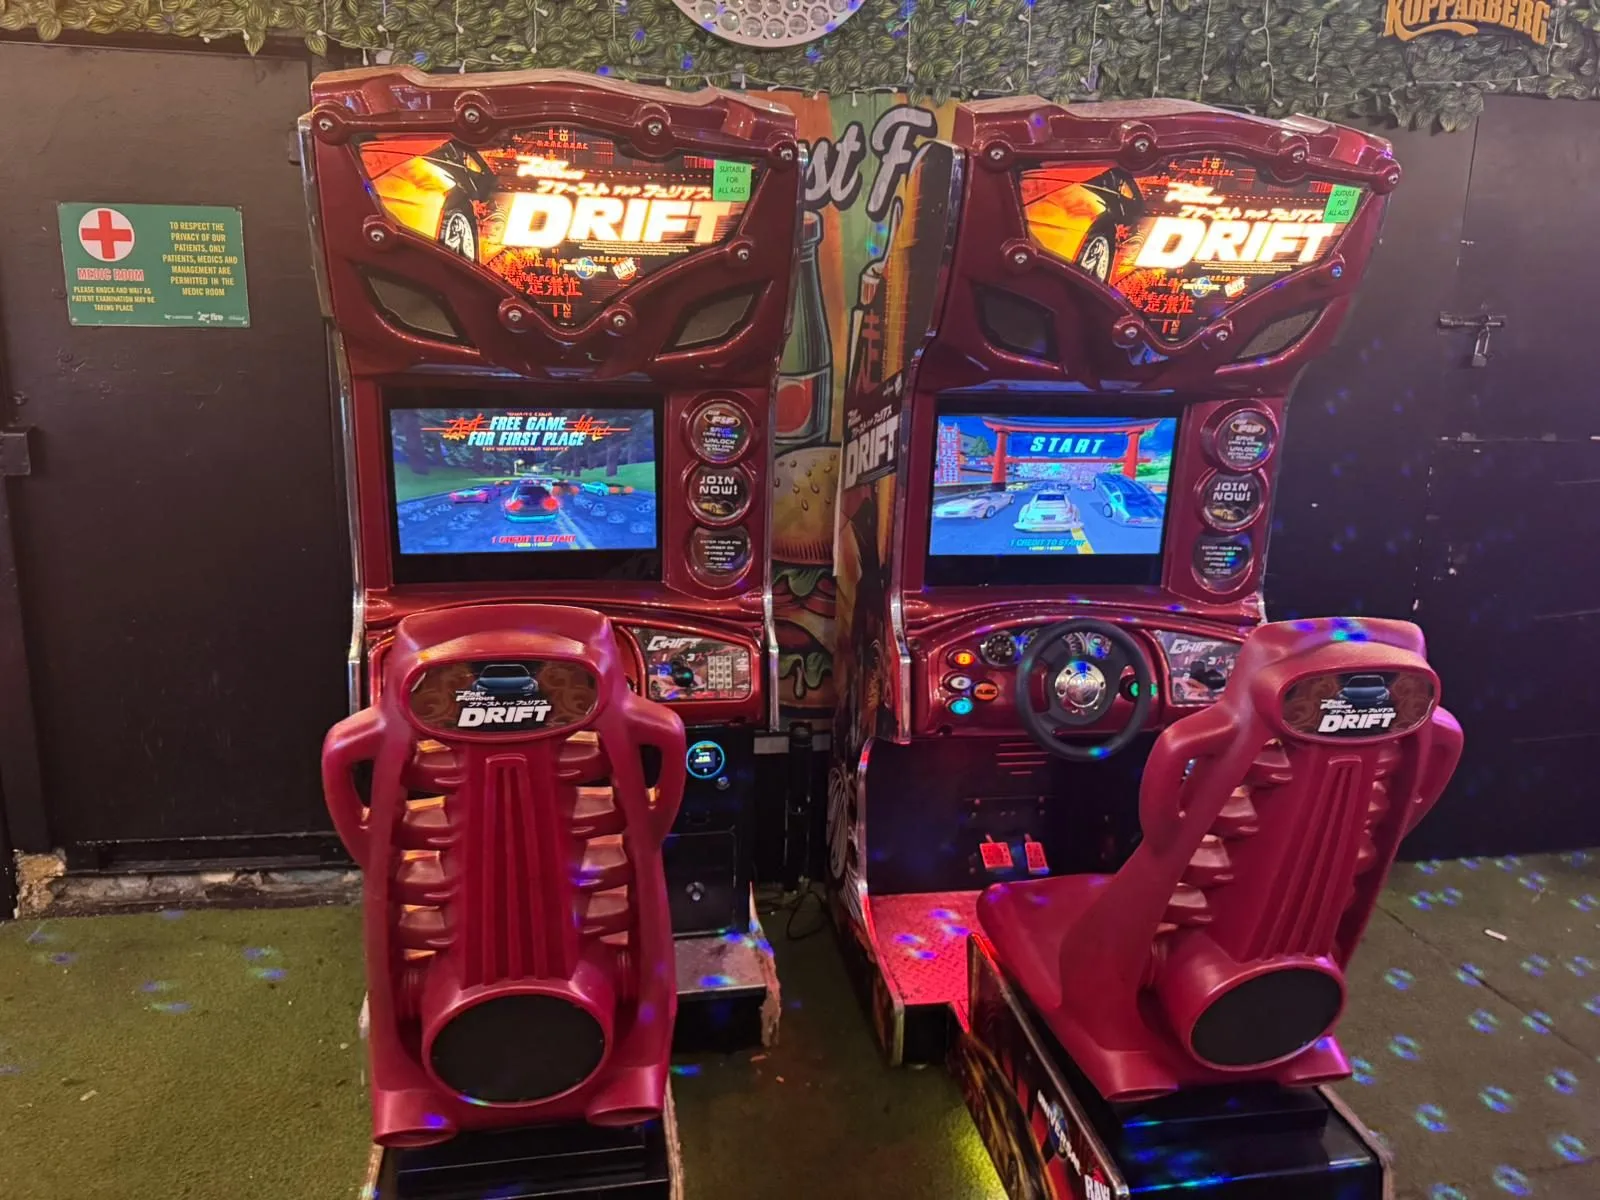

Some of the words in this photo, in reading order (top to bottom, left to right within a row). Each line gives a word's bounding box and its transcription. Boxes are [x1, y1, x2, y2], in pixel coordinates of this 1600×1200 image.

[1383, 0, 1551, 45] KOPPARBERG
[804, 121, 863, 210] st
[169, 222, 179, 230] TO
[180, 222, 210, 230] RESPECT
[212, 223, 224, 231] THE
[502, 194, 732, 249] DRIFT
[171, 233, 200, 241] PRIVACY
[202, 233, 210, 241] OF
[212, 234, 226, 242] OUR
[1135, 216, 1337, 269] DRIFT
[209, 244, 225, 253] ONLY
[162, 254, 196, 264] PATIENTS,
[197, 256, 223, 264] MEDICS
[224, 256, 238, 265] AND
[77, 267, 112, 281] MEDIC
[113, 268, 145, 281] ROOM
[171, 265, 217, 274] MANAGEMENT
[218, 267, 232, 275] ARE
[170, 276, 208, 285] PERMITTED
[221, 278, 235, 286] THE
[73, 286, 95, 294] PLEASE
[95, 286, 115, 294] KNOCK
[182, 287, 205, 296] MEDIC
[205, 288, 225, 297] ROOM
[72, 295, 95, 303] PATIENT
[95, 295, 134, 304] EXAMINATION
[147, 296, 156, 304] BE
[115, 304, 134, 312] PLACE
[490, 416, 522, 431] FREE
[526, 417, 568, 431] GAME
[467, 431, 496, 446] FOR
[499, 432, 541, 446] FIRST
[543, 432, 587, 446] PLACE
[1029, 436, 1106, 454] START
[844, 414, 901, 490] DRIFT
[700, 476, 735, 484] JOIN
[699, 485, 738, 495] NOW!
[1214, 482, 1249, 492] JOIN
[1212, 492, 1251, 501] NOW!
[533, 535, 546, 543] TO
[547, 534, 577, 543] START
[1016, 539, 1044, 547] CREDIT
[1046, 539, 1058, 547] TO
[457, 705, 553, 728] DRIFT
[1317, 712, 1397, 733] DRIFT
